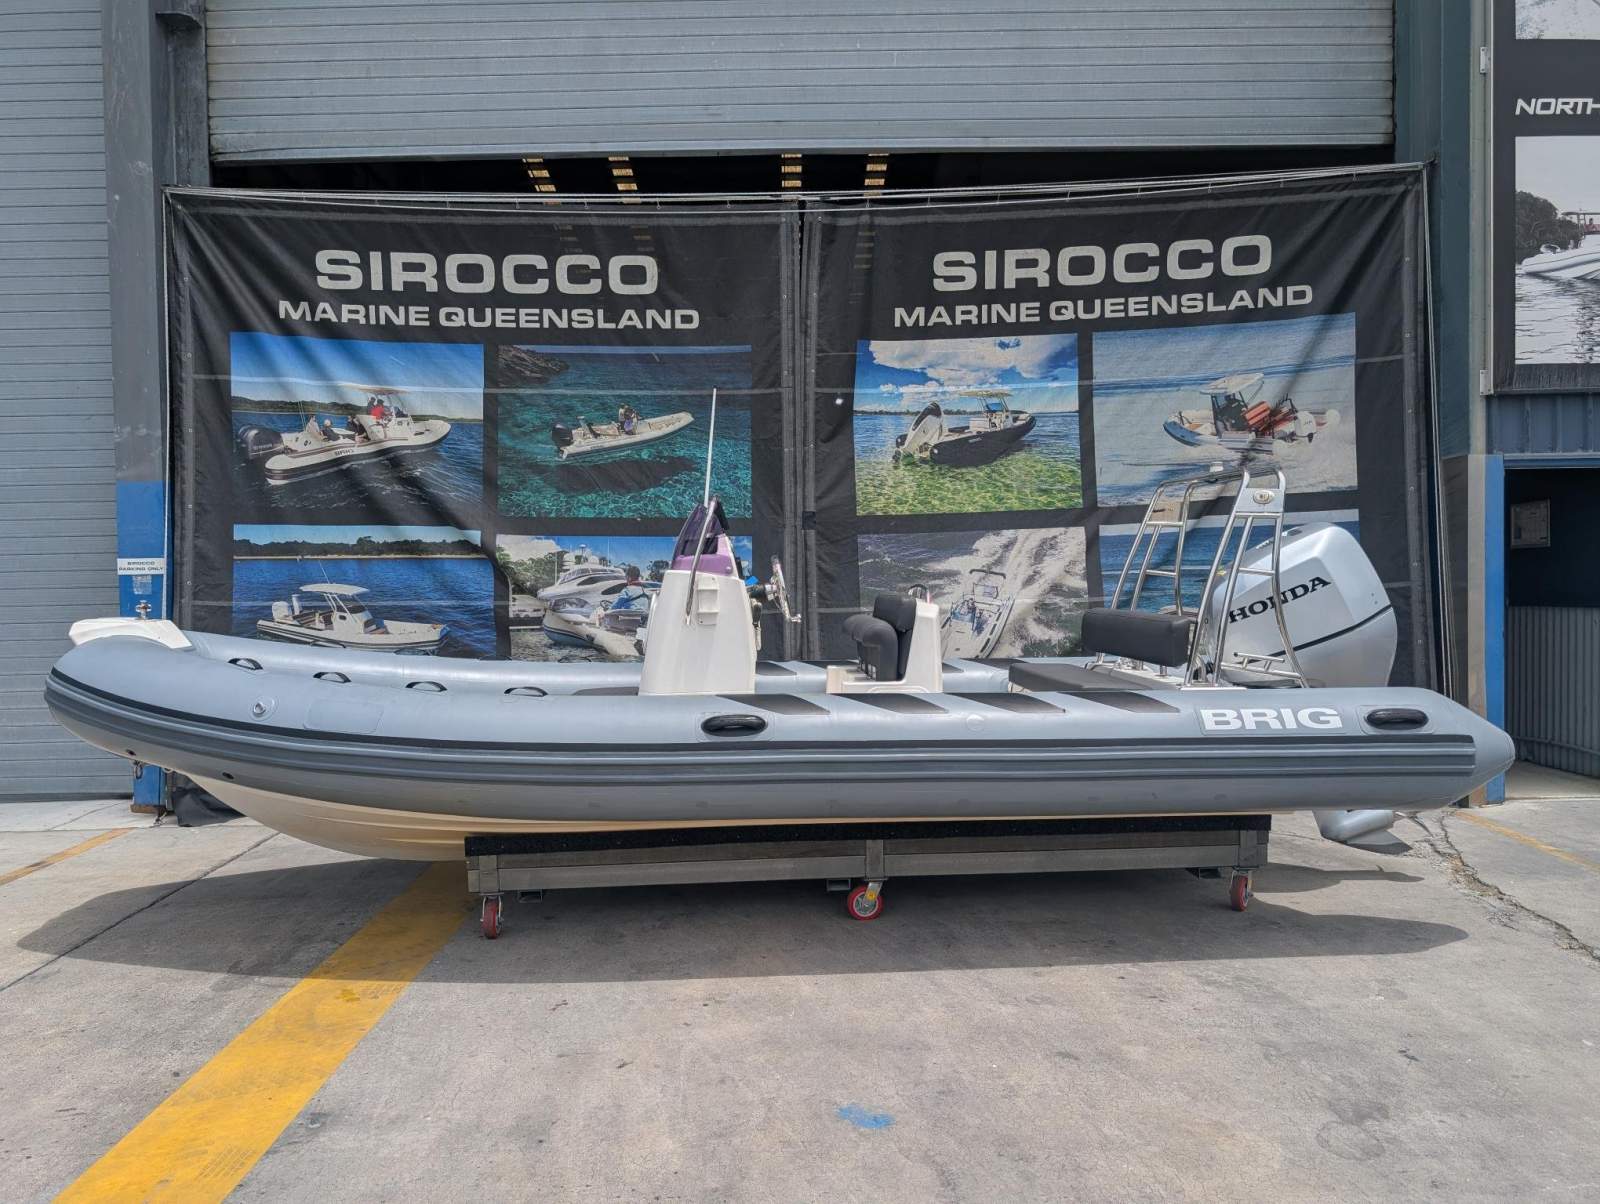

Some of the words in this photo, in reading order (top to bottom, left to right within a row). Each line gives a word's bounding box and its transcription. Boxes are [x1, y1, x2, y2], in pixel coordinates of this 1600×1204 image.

[316, 250, 659, 295] SIROCCO
[933, 235, 1272, 292] SIROCCO
[278, 300, 430, 327] MARINE
[438, 306, 700, 330] QUEENSLAND
[894, 302, 1041, 328] MARINE
[1049, 284, 1313, 321] QUEENSLAND
[1229, 576, 1331, 623] HONDA
[1199, 707, 1343, 731] BRIG
